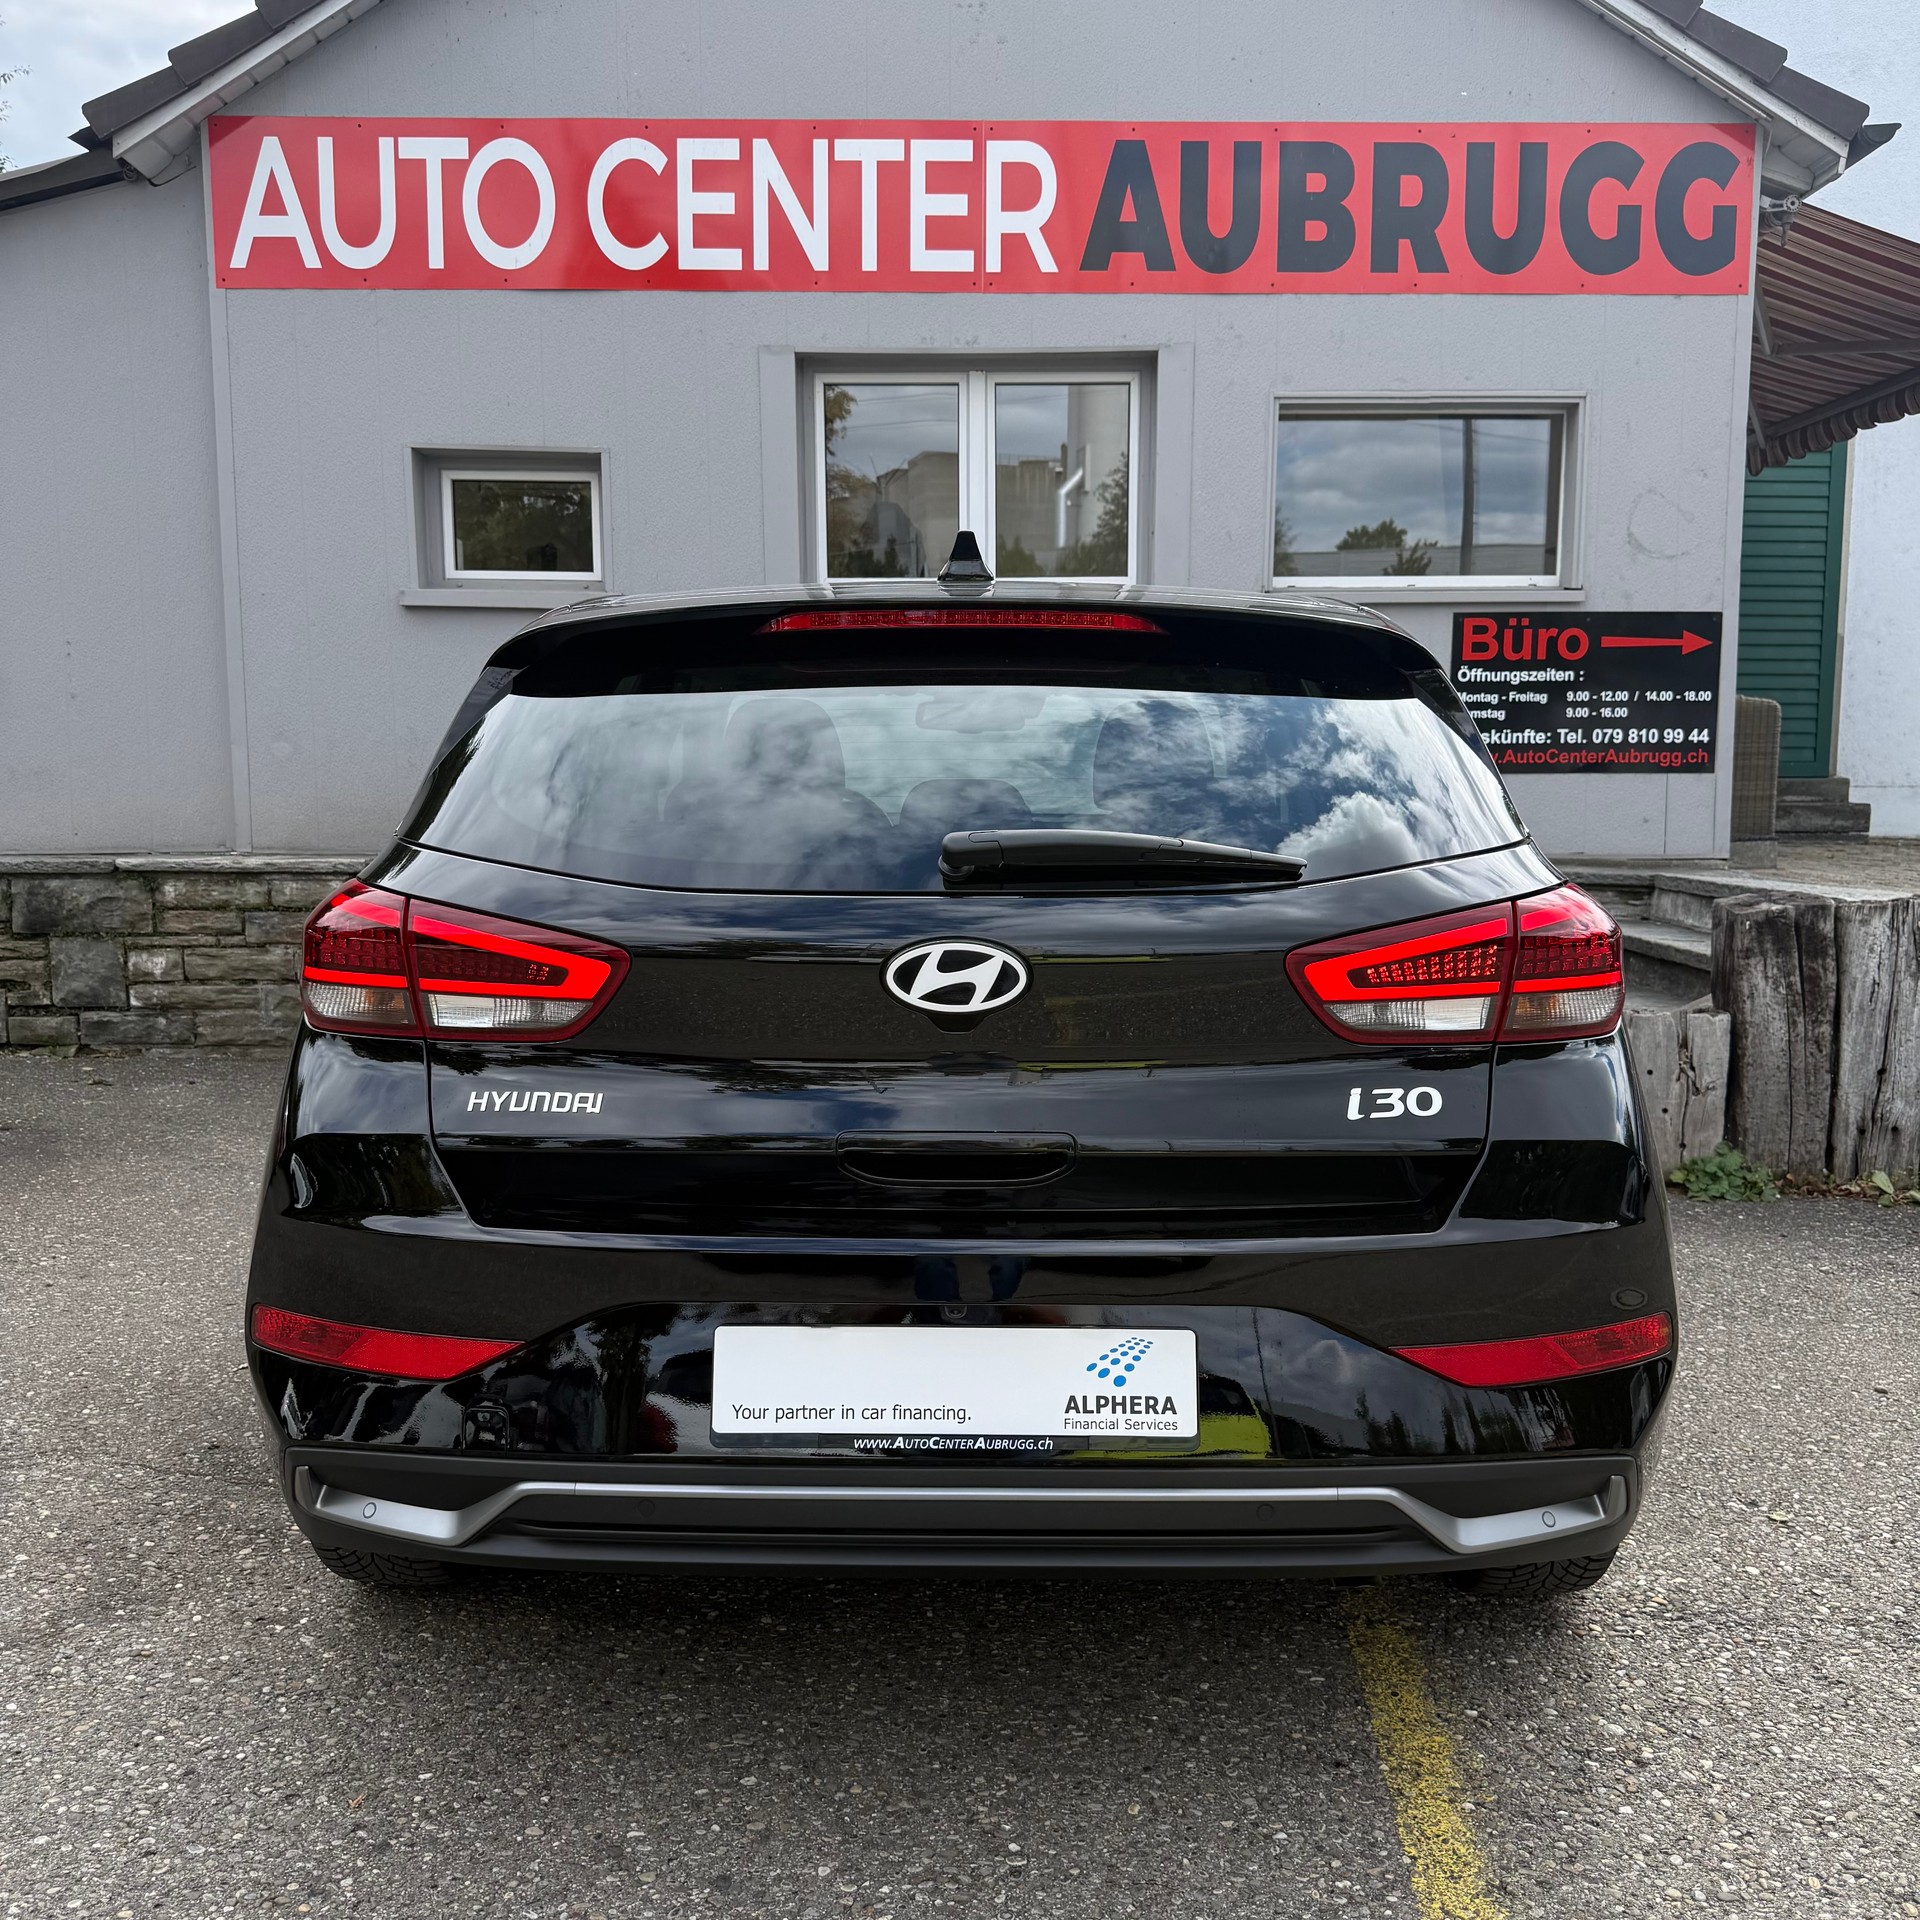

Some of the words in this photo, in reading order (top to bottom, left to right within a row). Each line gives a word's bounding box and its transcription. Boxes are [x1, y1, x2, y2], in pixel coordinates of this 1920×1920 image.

[229, 135, 556, 271] AUTO
[586, 137, 1058, 273] CENTER
[1079, 139, 1741, 276] AUBRUGG
[1462, 617, 1589, 661] Büro
[1457, 666, 1575, 685] Öffnungszeiten
[1509, 691, 1548, 704] Freitag
[1566, 691, 1590, 702] 9.00
[1600, 691, 1629, 702] 12.00
[1645, 691, 1673, 702] 14.00
[1683, 691, 1712, 702] 18.00
[1470, 709, 1506, 720] mstag
[1565, 707, 1589, 718] 9.00
[1600, 707, 1628, 718] 16.00
[1481, 729, 1552, 744] skünfte:
[1557, 728, 1587, 744] Tel.
[1592, 728, 1623, 744] 079
[1627, 728, 1659, 744] 810
[1663, 728, 1684, 744] 99
[1688, 728, 1710, 744] 44
[1493, 748, 1709, 767] .AutoCenterAubrugg.ch
[467, 1091, 603, 1114] HYUNDAI
[1346, 1086, 1443, 1121] i30
[732, 1404, 769, 1420] Your
[775, 1405, 835, 1423] partner
[841, 1404, 855, 1420] in
[861, 1407, 886, 1420] car
[892, 1404, 972, 1424] financing.
[1064, 1395, 1178, 1415] ALPHERA
[1064, 1418, 1119, 1430] Financial
[1124, 1419, 1178, 1431] Services
